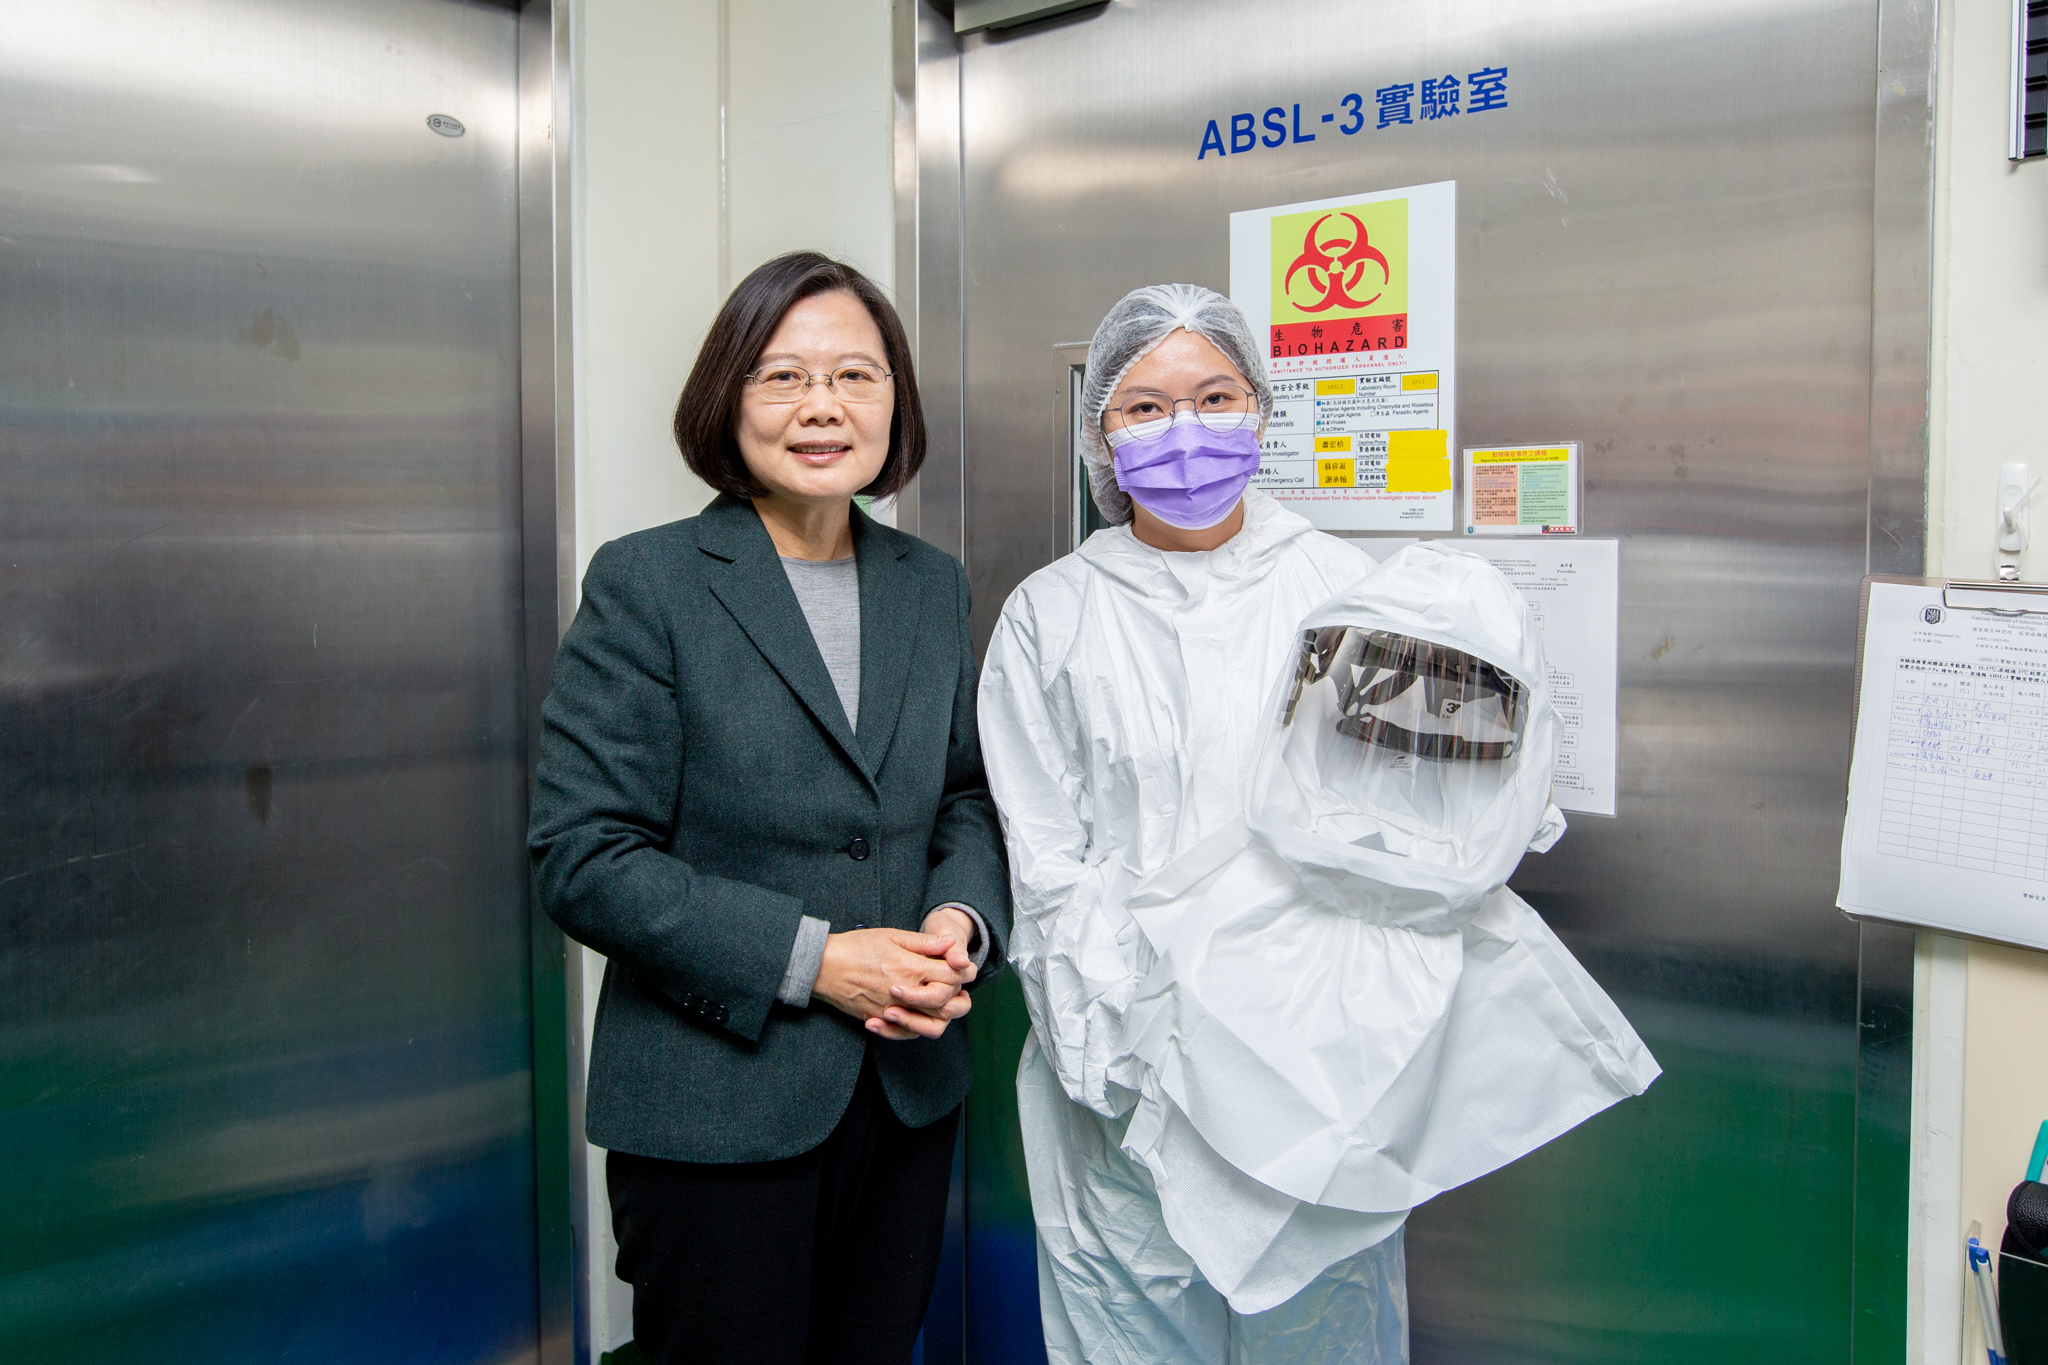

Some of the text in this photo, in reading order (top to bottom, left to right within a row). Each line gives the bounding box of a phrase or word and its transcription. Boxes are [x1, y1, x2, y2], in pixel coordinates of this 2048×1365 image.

[1197, 67, 1508, 161] ABSL-3 實驗室
[1274, 318, 1404, 342] 生物危害
[1273, 336, 1404, 357] BIOHAZARD
[1359, 375, 1391, 384] 實驗室編號
[1266, 420, 1294, 428] Materials
